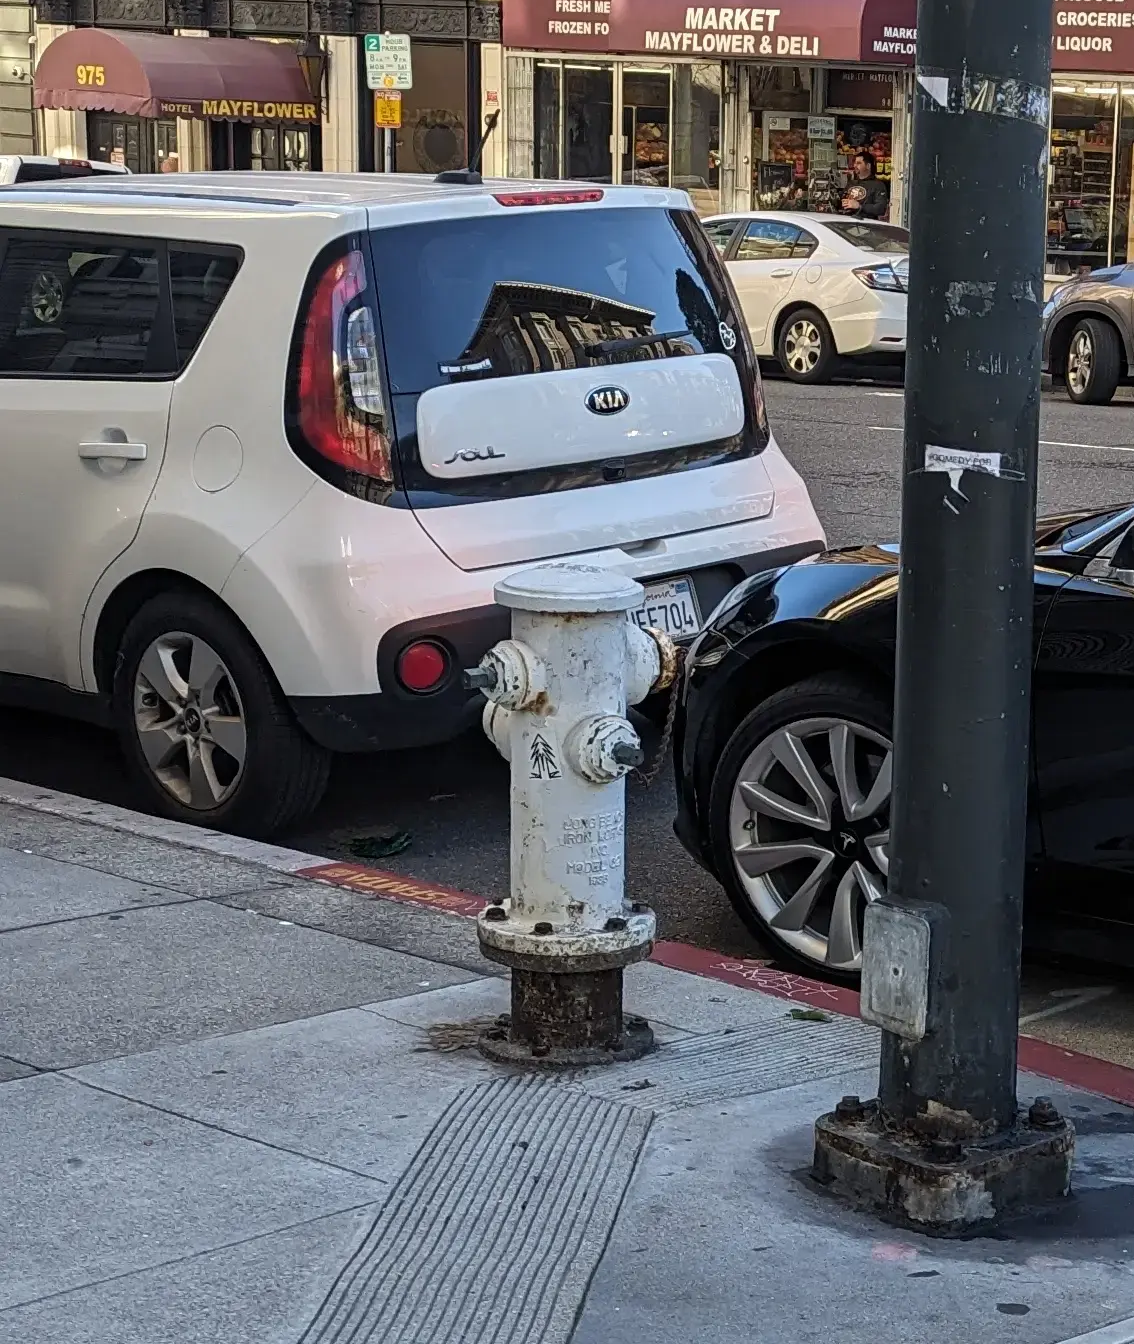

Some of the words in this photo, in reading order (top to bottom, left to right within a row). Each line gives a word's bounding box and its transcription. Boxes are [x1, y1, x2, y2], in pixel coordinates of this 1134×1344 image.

[555, 0, 591, 13] FRESH
[548, 20, 592, 35] FROZEN
[685, 7, 781, 32] MARKET
[368, 38, 378, 50] 2
[645, 31, 755, 54] MAYFLOWER
[759, 35, 773, 55] &
[777, 36, 819, 56] DELI
[873, 40, 917, 54] MAYFLO
[1056, 36, 1113, 52] LIQUOR
[76, 65, 105, 86] 975
[160, 103, 195, 114] HOTEL
[202, 99, 317, 119] MAYFLOWER
[592, 389, 626, 410] KIA
